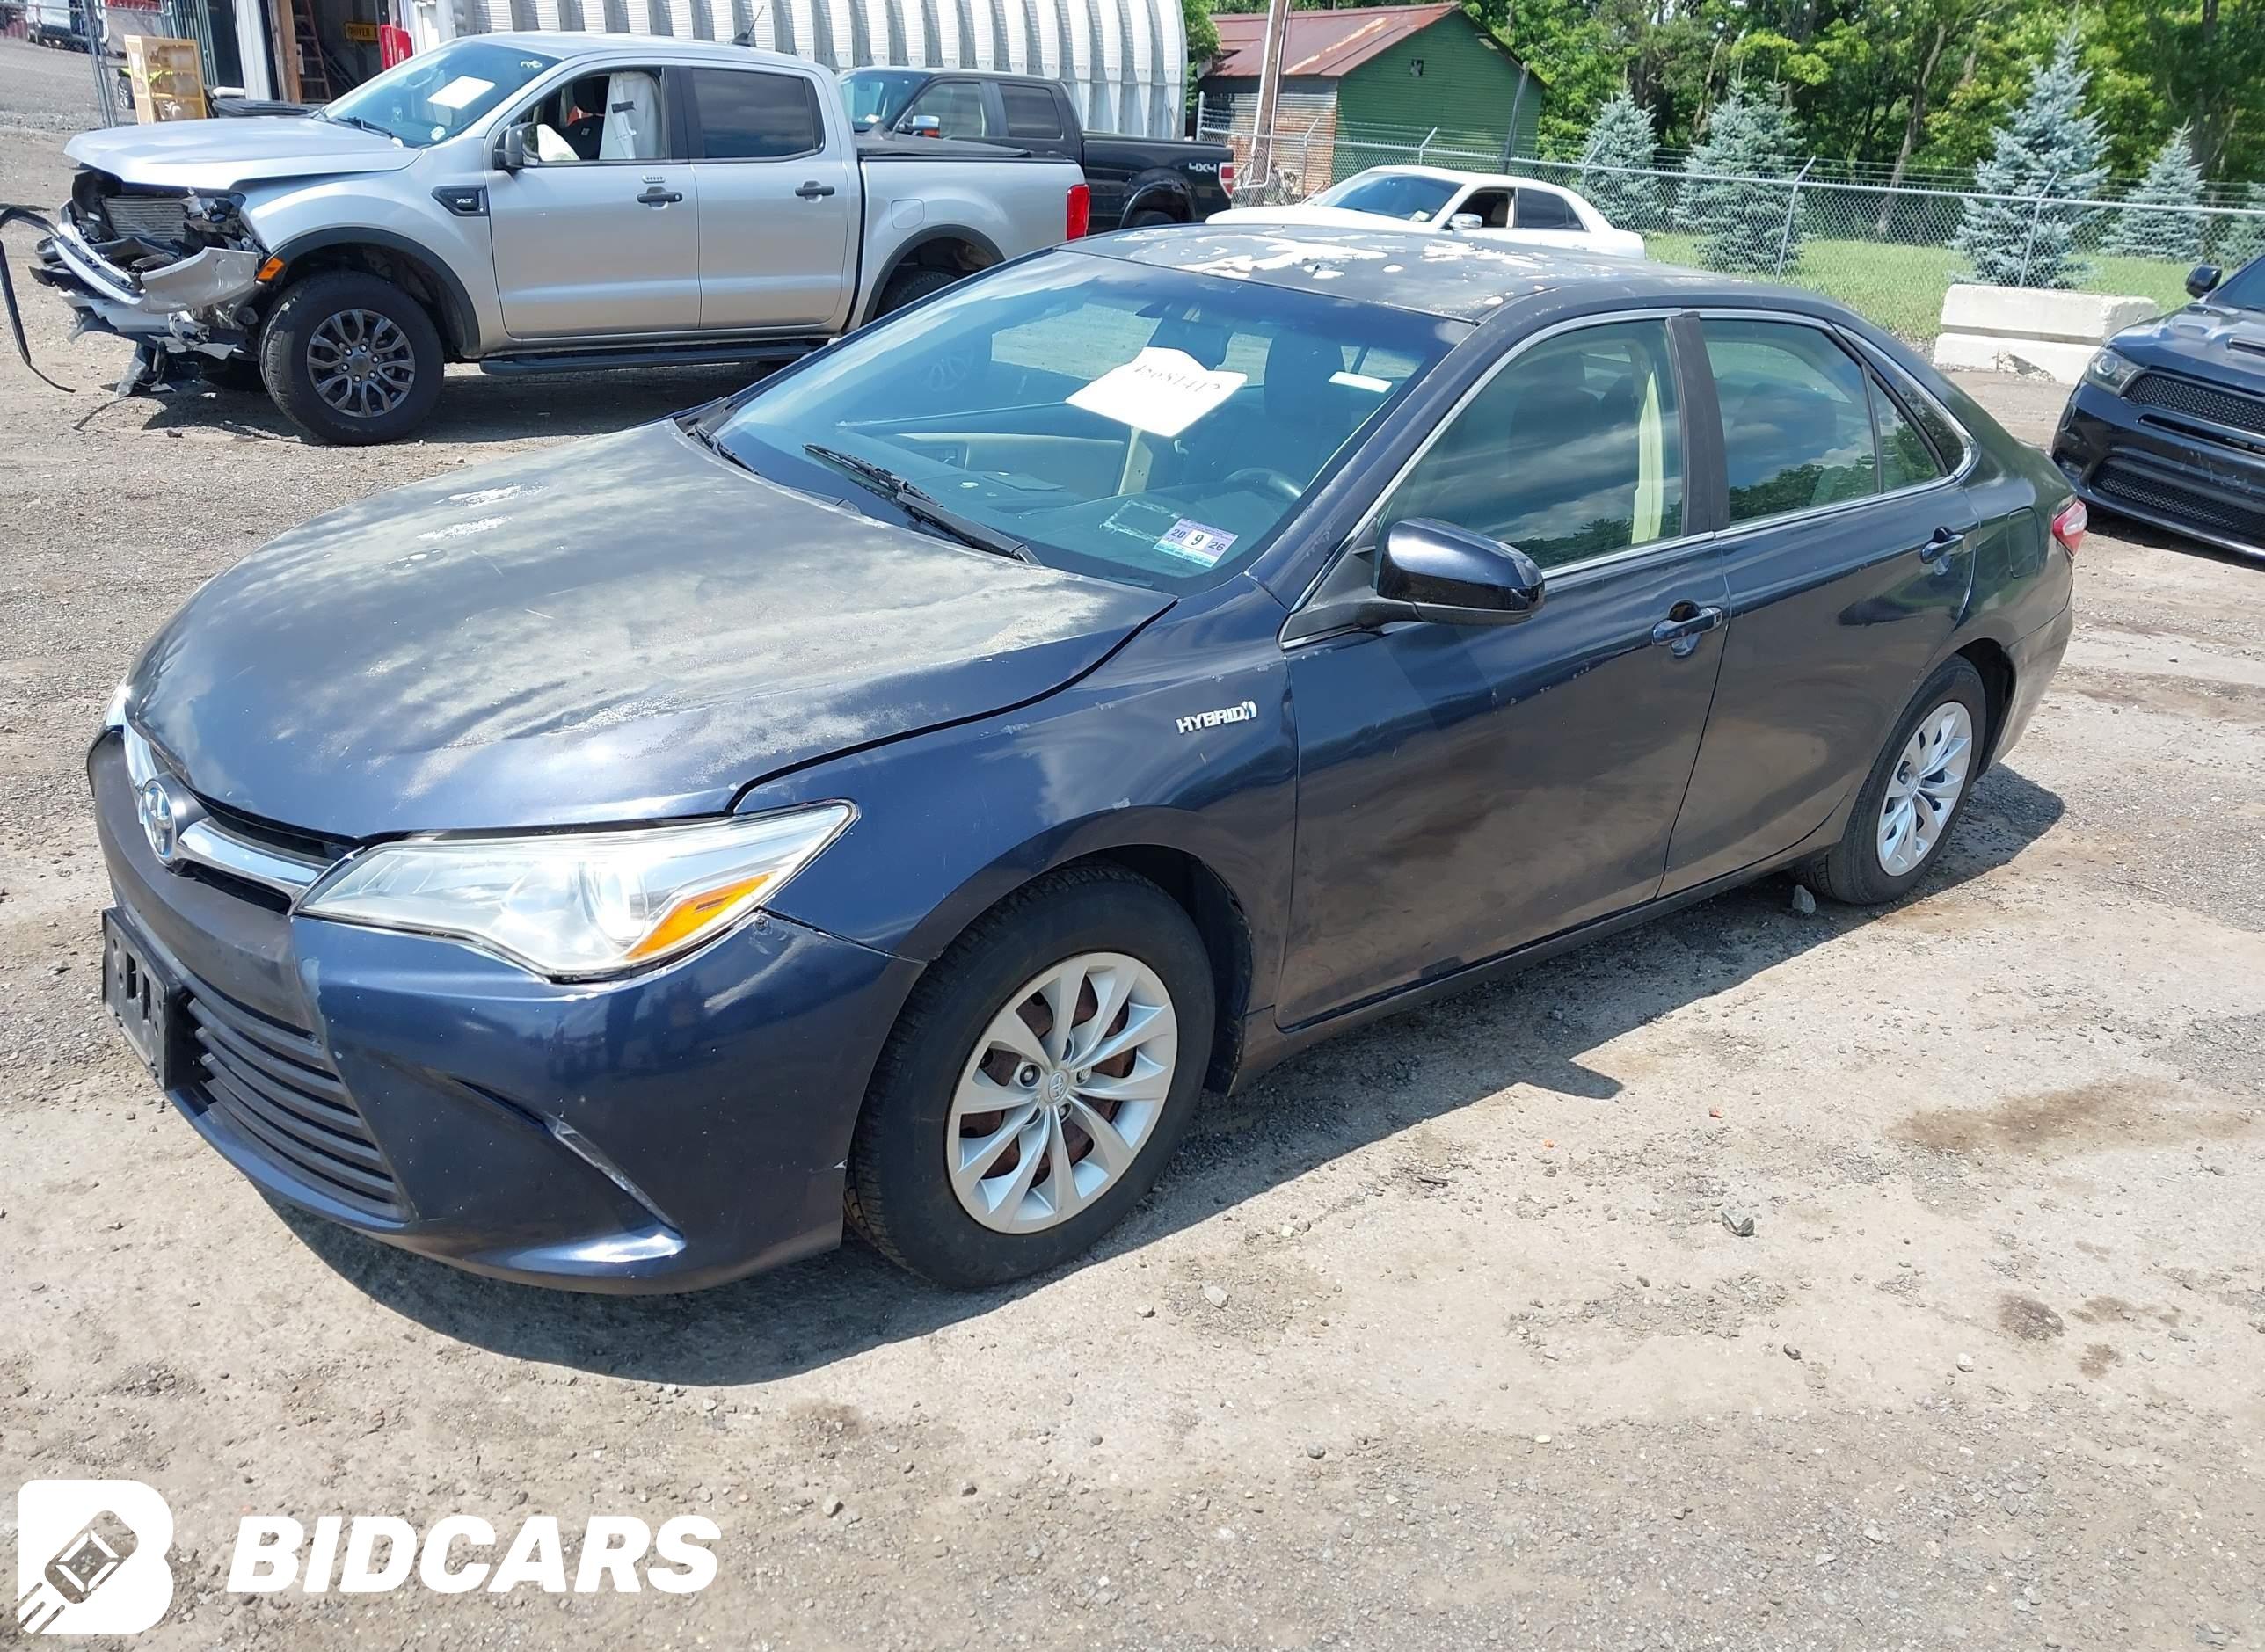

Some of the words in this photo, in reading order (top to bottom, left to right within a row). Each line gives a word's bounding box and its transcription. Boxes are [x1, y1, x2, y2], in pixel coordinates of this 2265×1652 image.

[1170, 528, 1187, 539] 20
[1191, 534, 1205, 546] 9
[1208, 541, 1226, 551] 26
[1176, 705, 1246, 734] HYBRID
